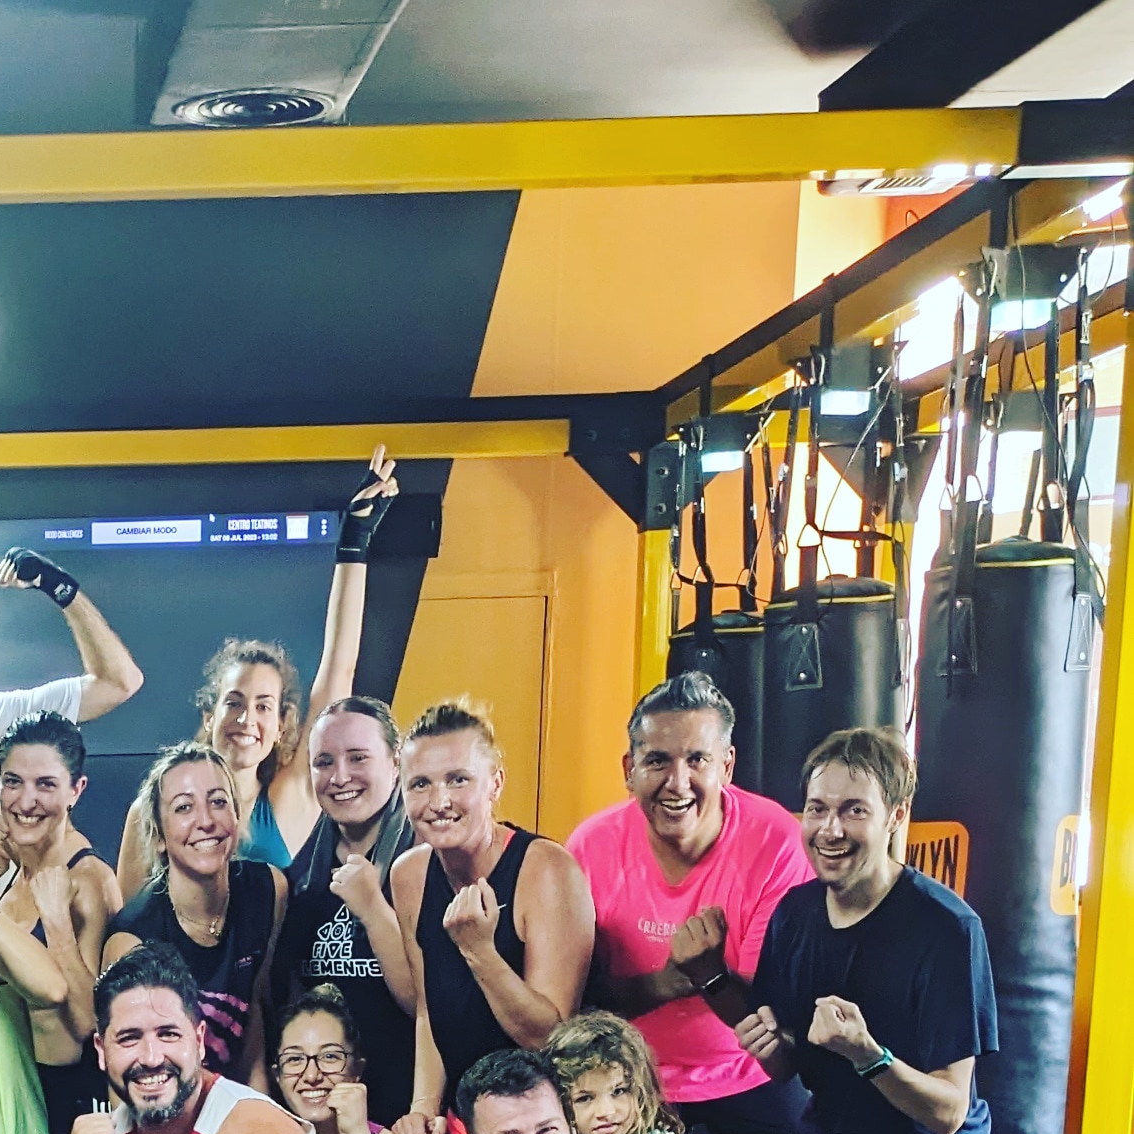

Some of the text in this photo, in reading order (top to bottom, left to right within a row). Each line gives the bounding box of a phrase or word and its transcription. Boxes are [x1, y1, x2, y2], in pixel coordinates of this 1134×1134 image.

[116, 526, 177, 536] CAMBIAR MODO
[312, 941, 354, 959] FIVE
